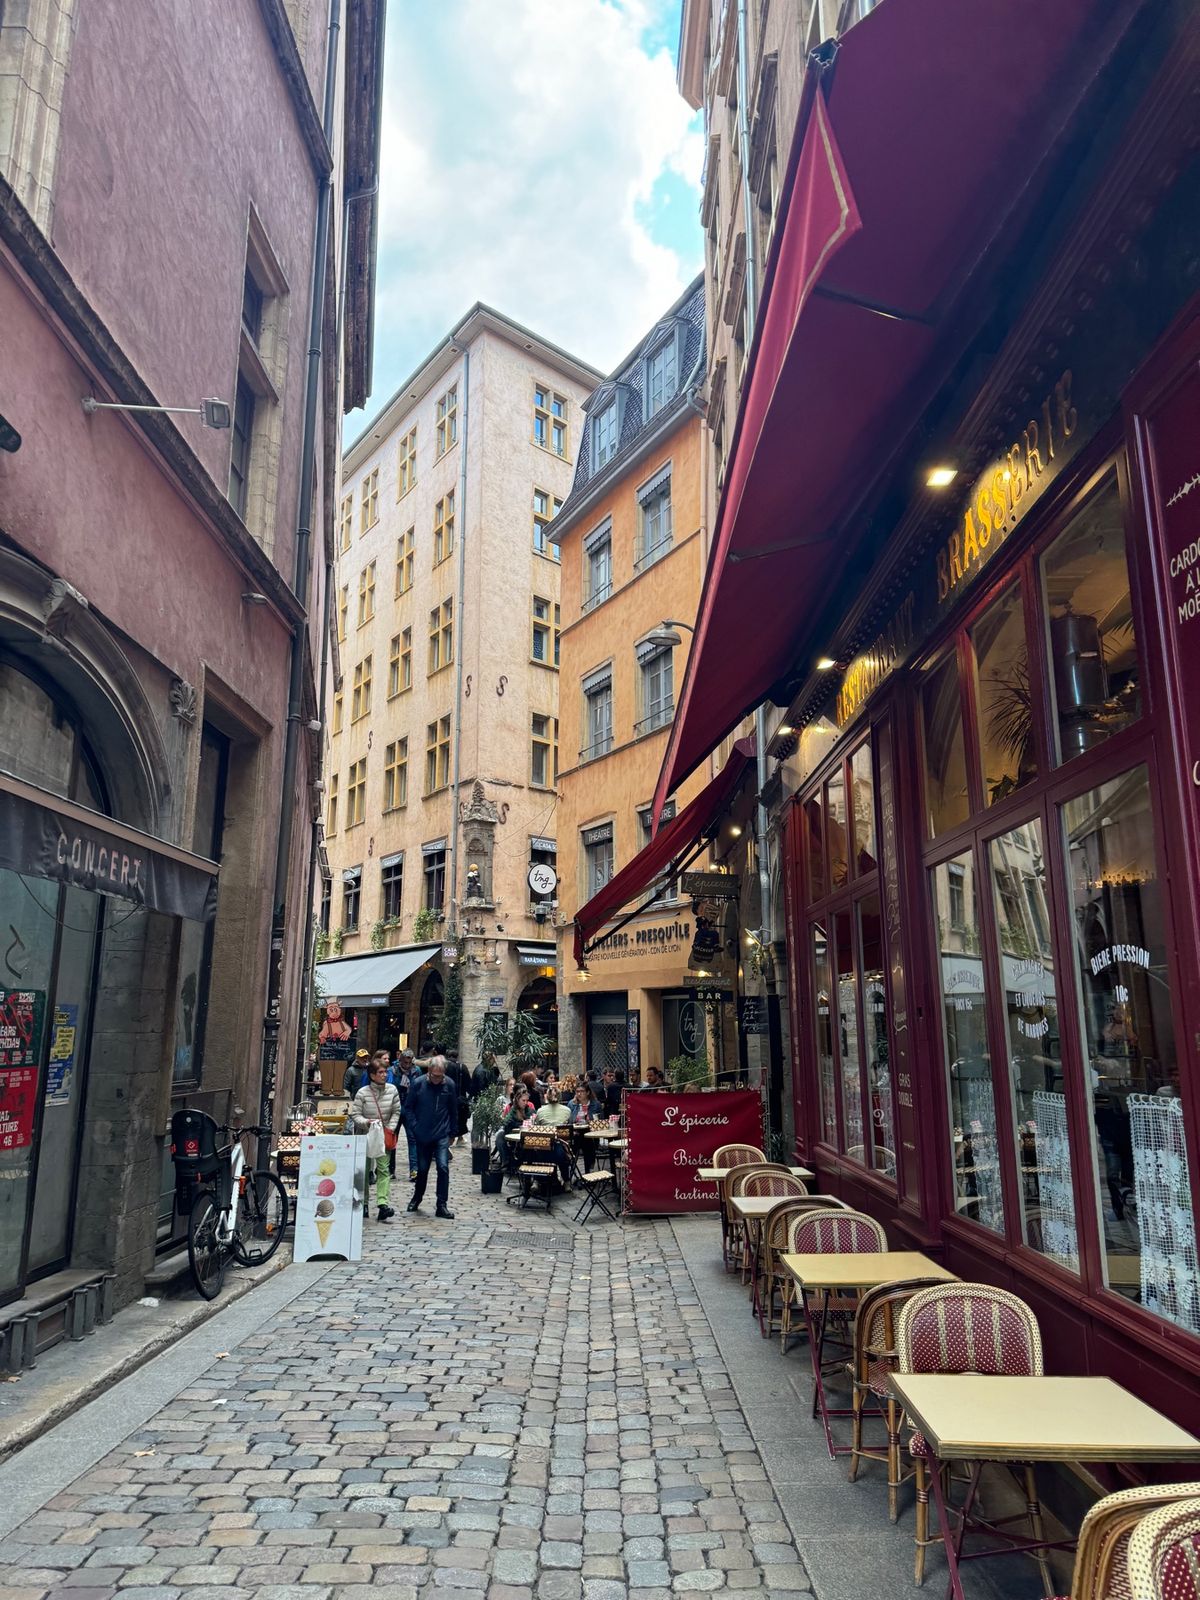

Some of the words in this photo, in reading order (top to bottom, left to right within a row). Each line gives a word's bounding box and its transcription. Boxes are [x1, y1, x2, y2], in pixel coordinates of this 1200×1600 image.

[936, 368, 1077, 604] BRASSERIE
[57, 832, 140, 886] CONCERT
[636, 920, 690, 944] PRESQU'ÎLE
[1090, 948, 1111, 976] BIERE
[1112, 944, 1150, 969] PRESSION
[697, 992, 722, 1000] BAR
[661, 1106, 729, 1133] L'épicerie
